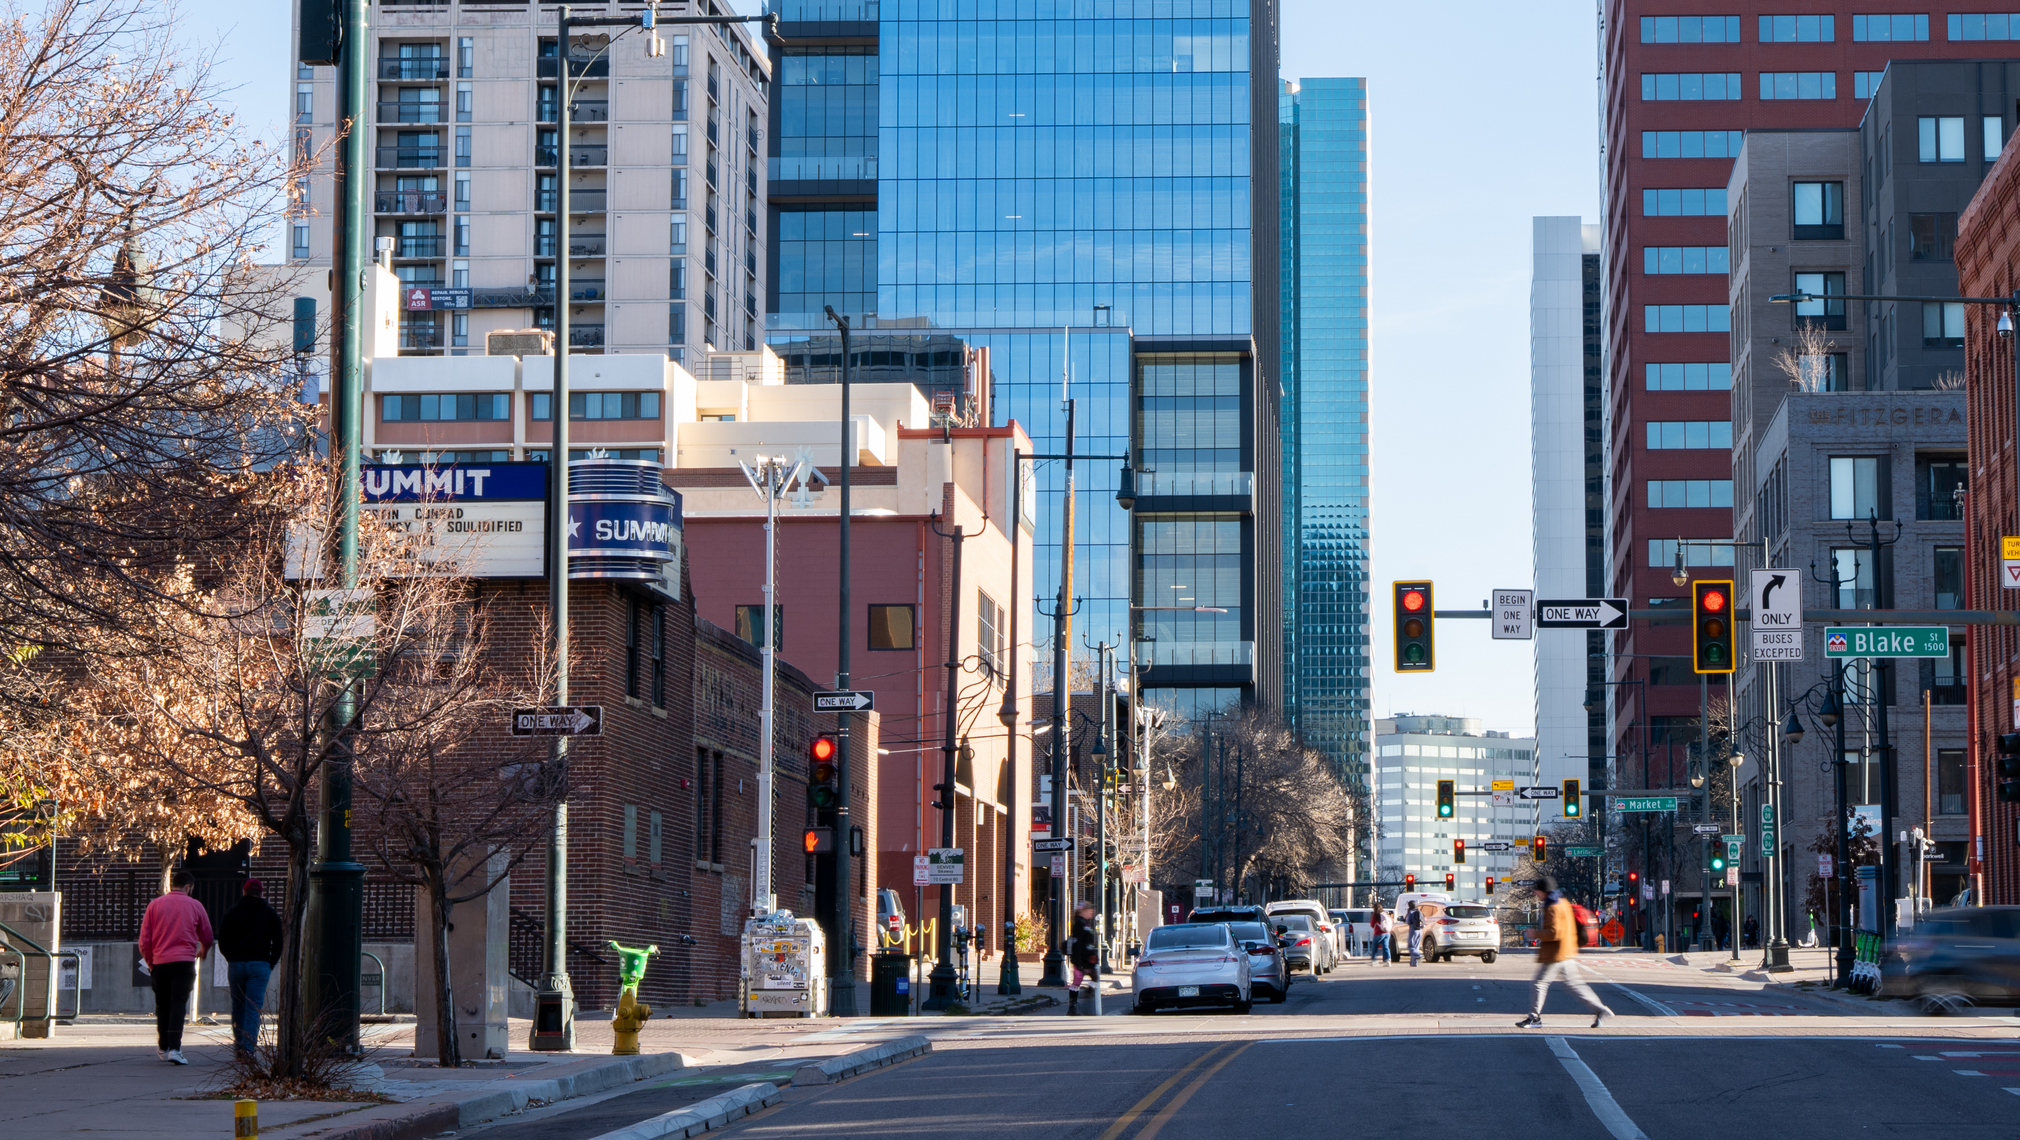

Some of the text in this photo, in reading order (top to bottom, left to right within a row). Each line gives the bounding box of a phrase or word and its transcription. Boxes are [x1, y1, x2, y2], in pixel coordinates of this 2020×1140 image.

[1810, 410, 1830, 418] THE
[360, 469, 491, 497] UMMIT
[1500, 595, 1525, 604] BEGIN
[1503, 611, 1521, 620] ONE
[1546, 608, 1600, 620] ONE WAY
[1761, 613, 1792, 625] ONLY
[1503, 625, 1521, 634] WAY
[1762, 634, 1793, 644] BUSES
[1855, 632, 1915, 652] Blake
[1929, 633, 1938, 642] St
[1924, 643, 1945, 651] 1500
[1754, 647, 1801, 658] EXCEPTED
[820, 697, 856, 706] ONE WAY
[521, 715, 574, 727] ONE WAY
[1629, 799, 1661, 809] Market
[73, 948, 88, 956] The
